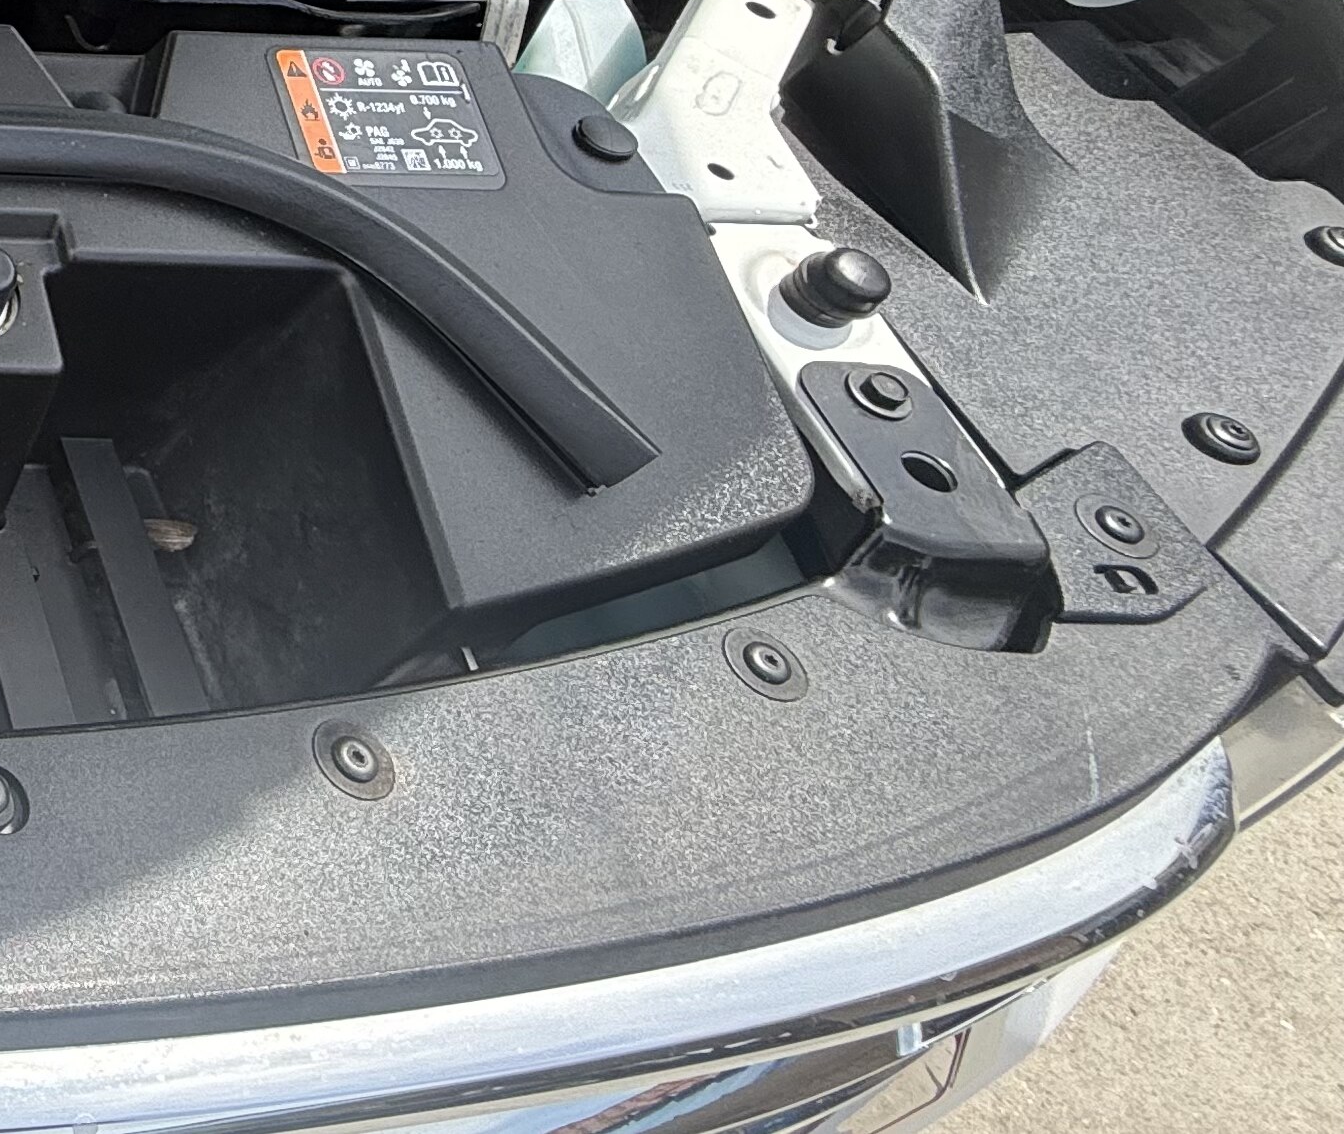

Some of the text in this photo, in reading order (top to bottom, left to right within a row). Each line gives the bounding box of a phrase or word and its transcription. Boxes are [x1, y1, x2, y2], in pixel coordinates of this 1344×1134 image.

[358, 77, 383, 86] AUTO
[440, 95, 457, 108] kg
[365, 125, 390, 138] PAG
[467, 159, 484, 172] kg
